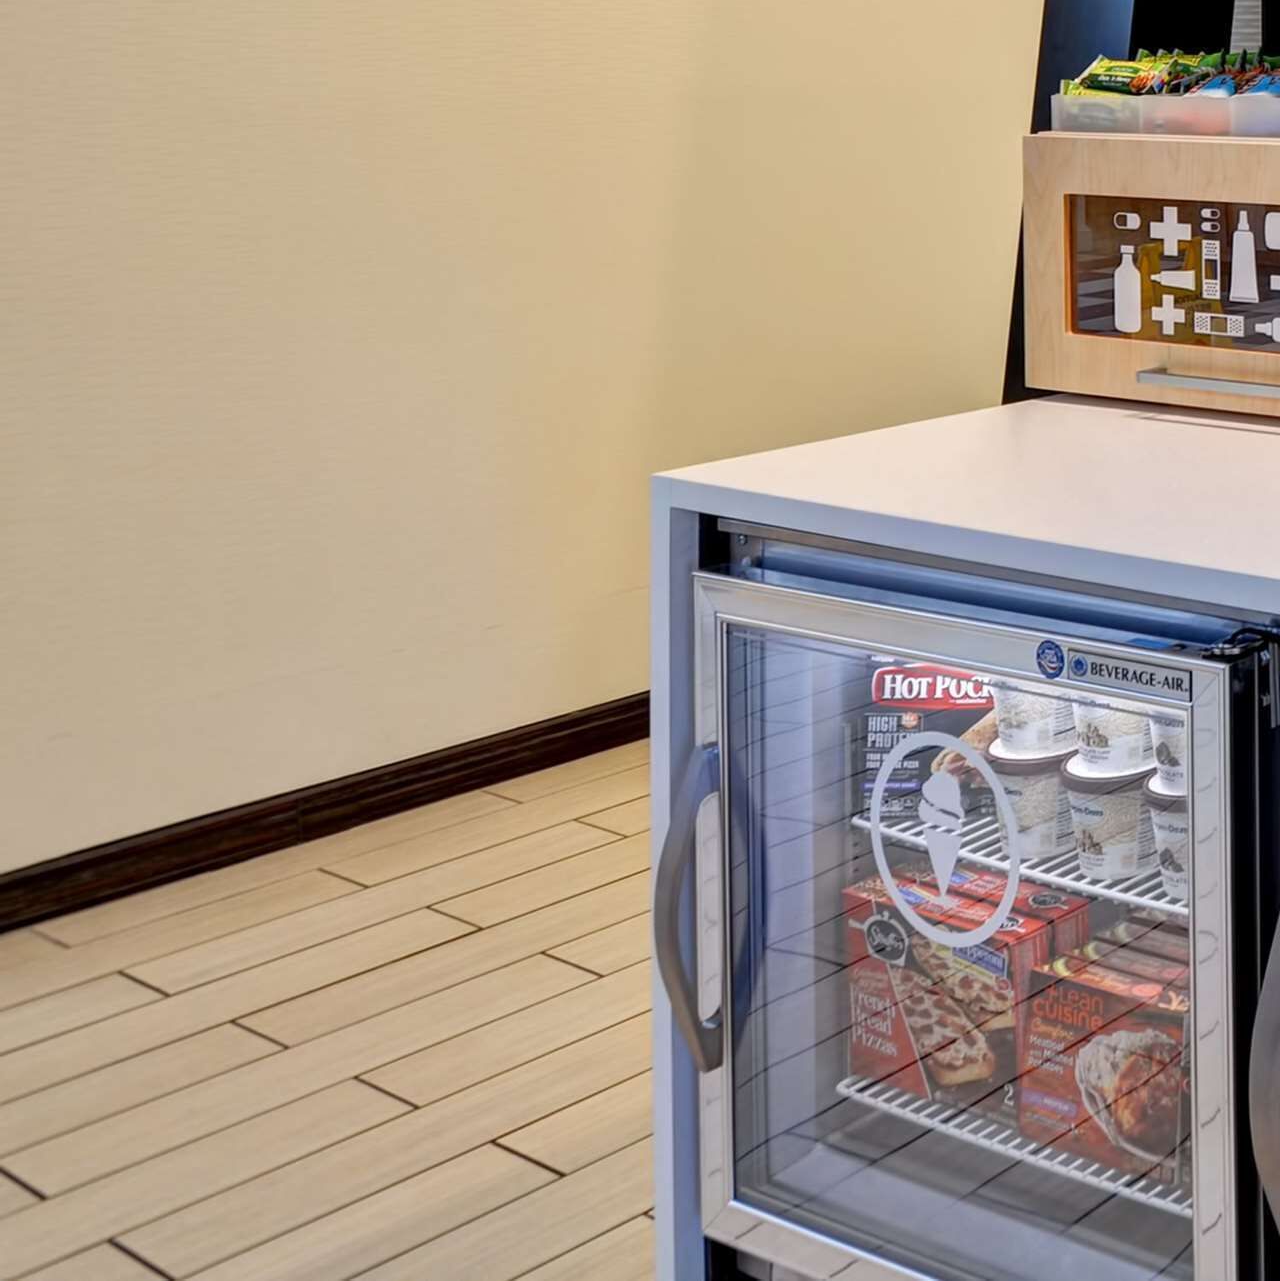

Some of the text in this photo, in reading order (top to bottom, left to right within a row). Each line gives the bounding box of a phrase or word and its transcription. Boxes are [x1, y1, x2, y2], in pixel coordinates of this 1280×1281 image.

[882, 674, 933, 700] HOT
[1090, 662, 1184, 692] BEVERAGE-AIR
[868, 716, 898, 732] HIGH
[1004, 1083, 1014, 1106] 2
